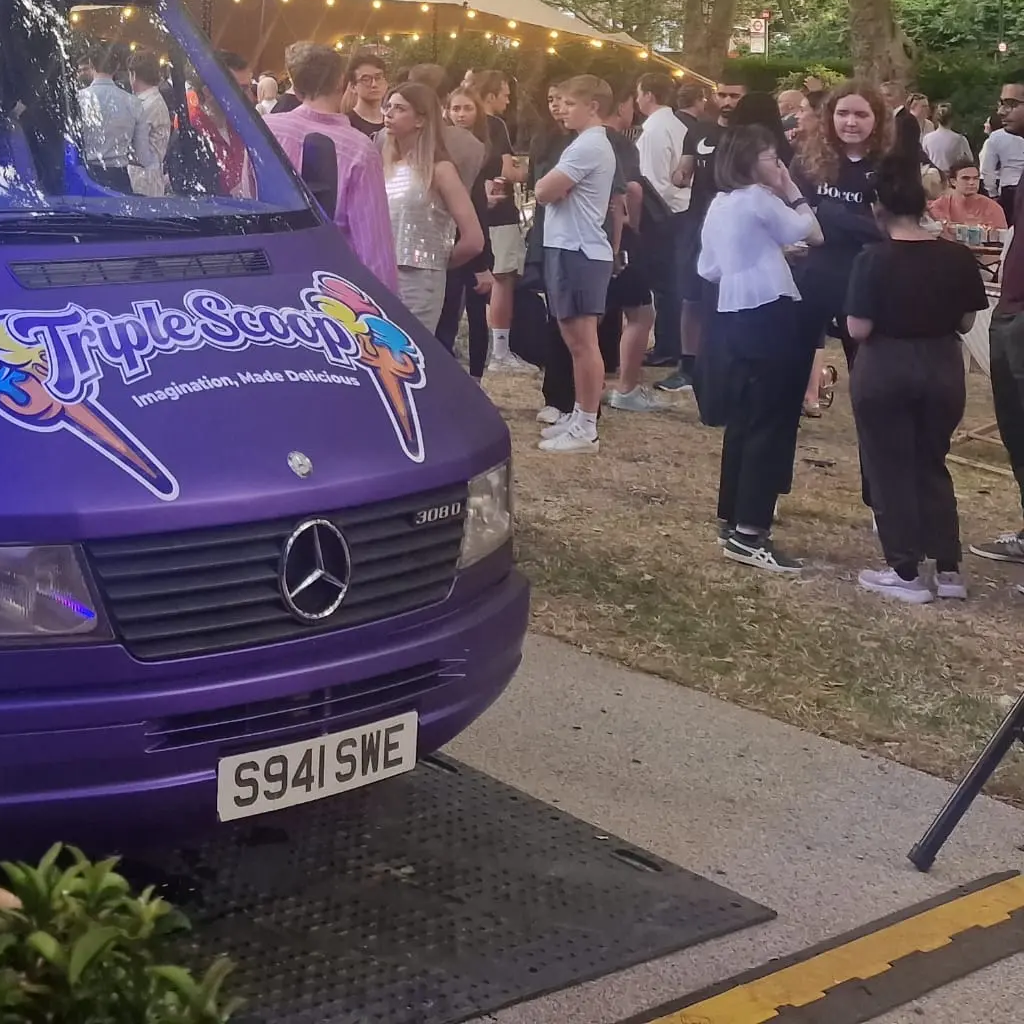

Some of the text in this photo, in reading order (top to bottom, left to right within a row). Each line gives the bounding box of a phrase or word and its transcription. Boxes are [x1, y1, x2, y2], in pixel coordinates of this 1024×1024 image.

[8, 289, 360, 402] Triple Scoop
[132, 368, 360, 408] Imagination, Made Delicious
[415, 504, 449, 525] 308
[233, 723, 405, 807] S941 SWE
